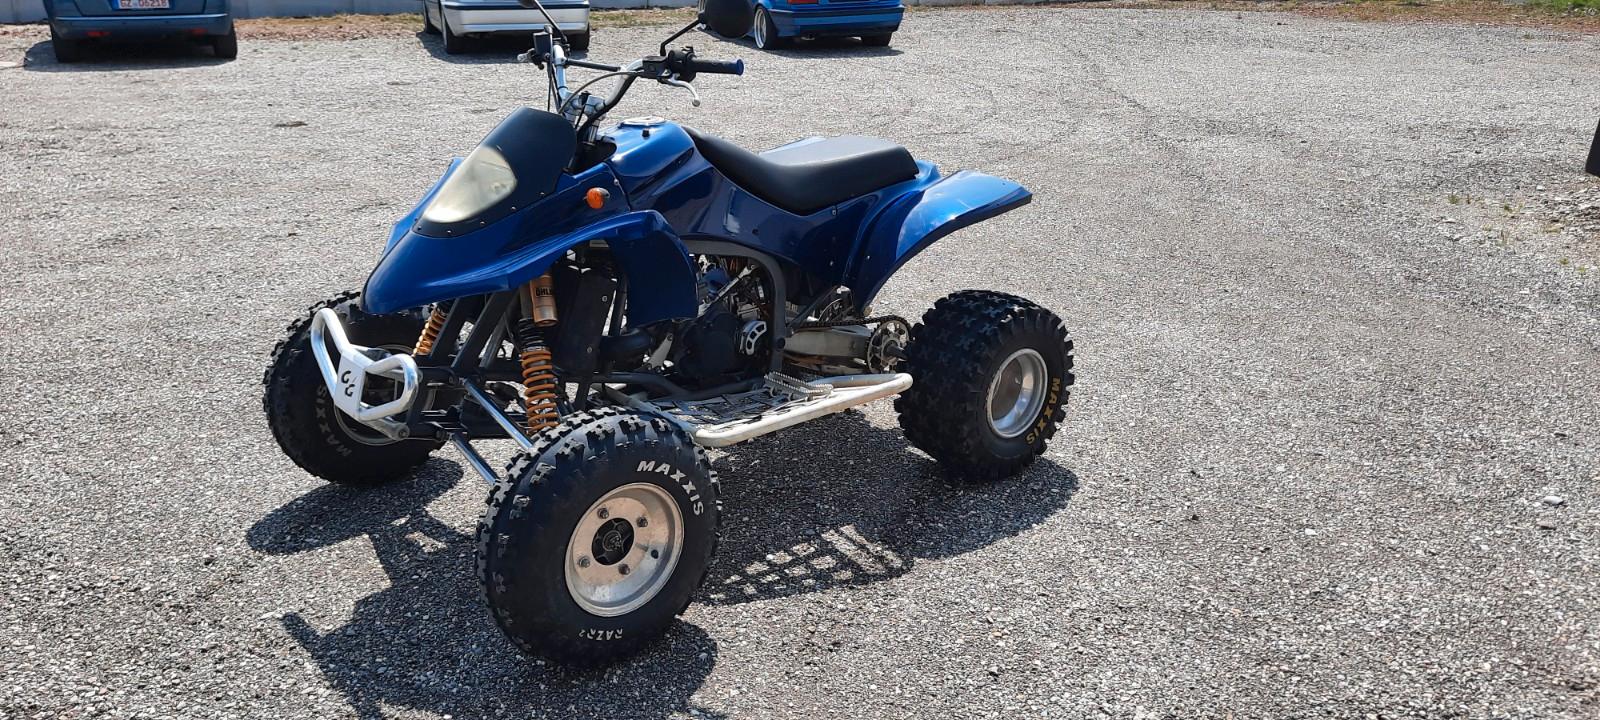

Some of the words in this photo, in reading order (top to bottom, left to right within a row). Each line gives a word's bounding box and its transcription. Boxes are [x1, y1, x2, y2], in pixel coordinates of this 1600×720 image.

[316, 385, 352, 457] MAXXIS
[1026, 377, 1061, 444] MAXXIS
[636, 460, 704, 516] MAXXIS
